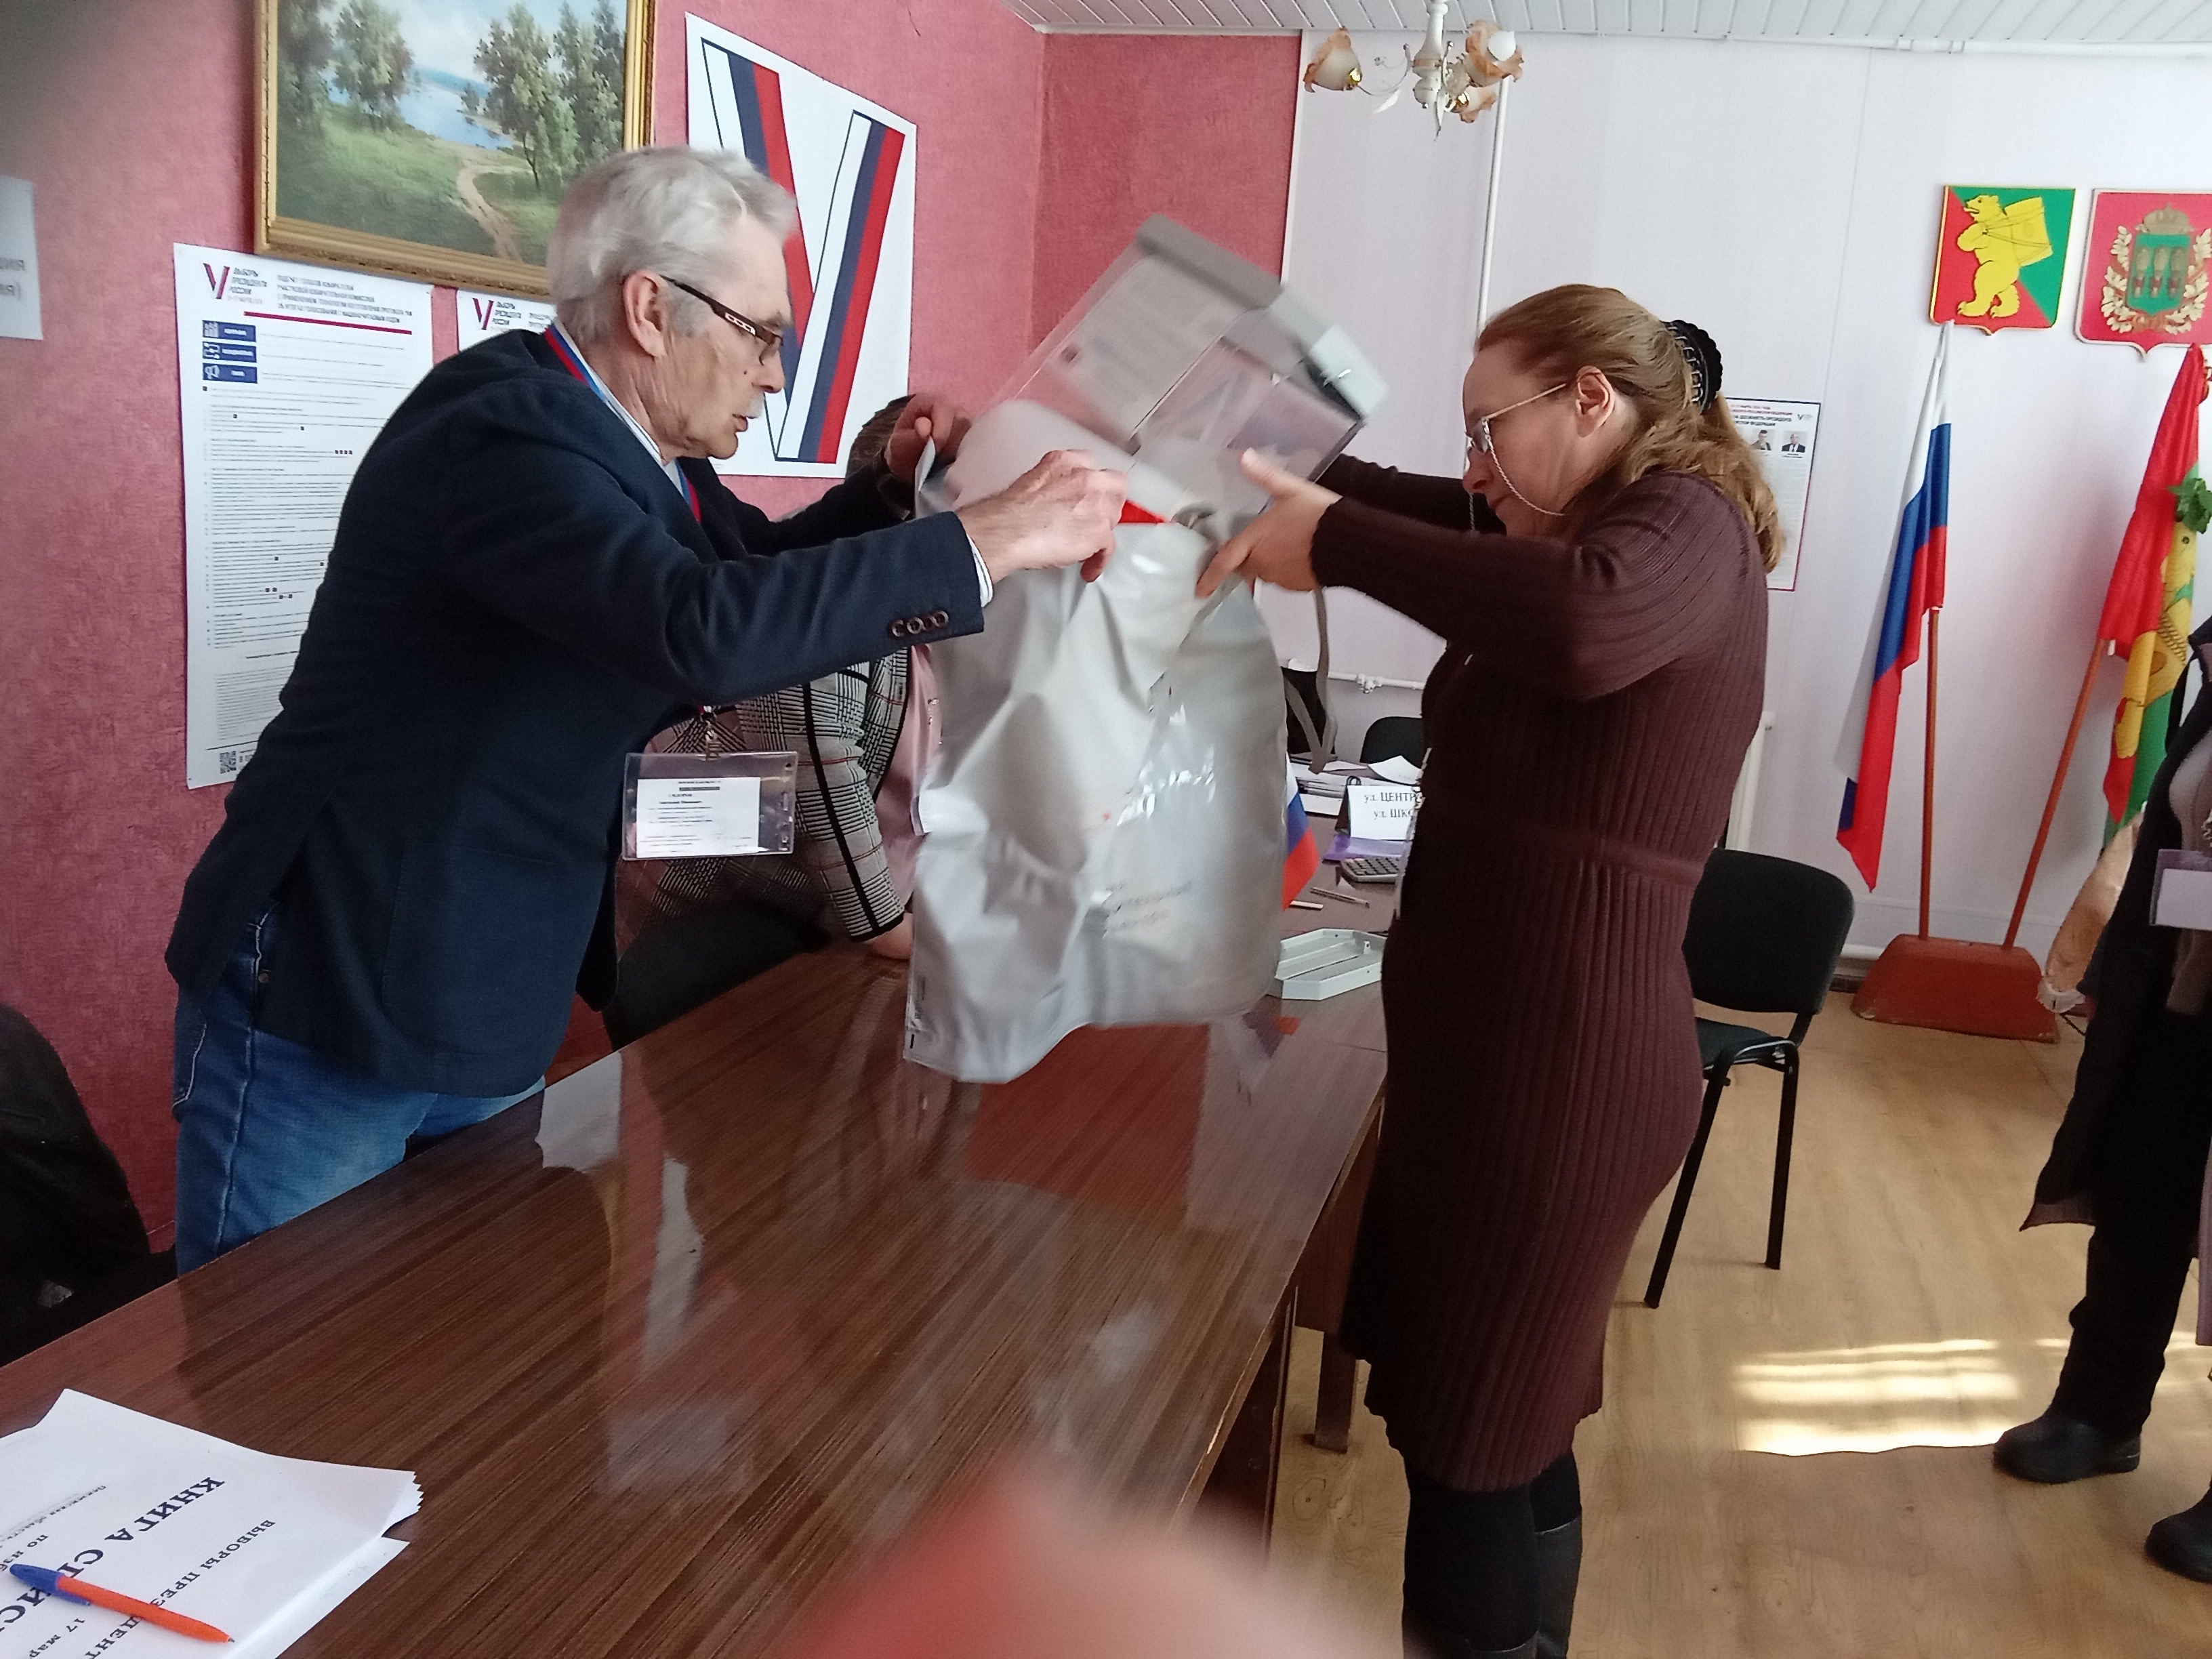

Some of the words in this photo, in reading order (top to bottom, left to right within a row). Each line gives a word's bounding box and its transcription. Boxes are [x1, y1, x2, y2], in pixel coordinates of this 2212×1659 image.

[104, 1477, 225, 1541] КНИГА
[27, 1534, 48, 1547] по
[200, 1519, 275, 1570] ВЫБОРЫ
[66, 1618, 85, 1633] 17
[85, 1572, 201, 1659] ПРЕЗДЕНТ
